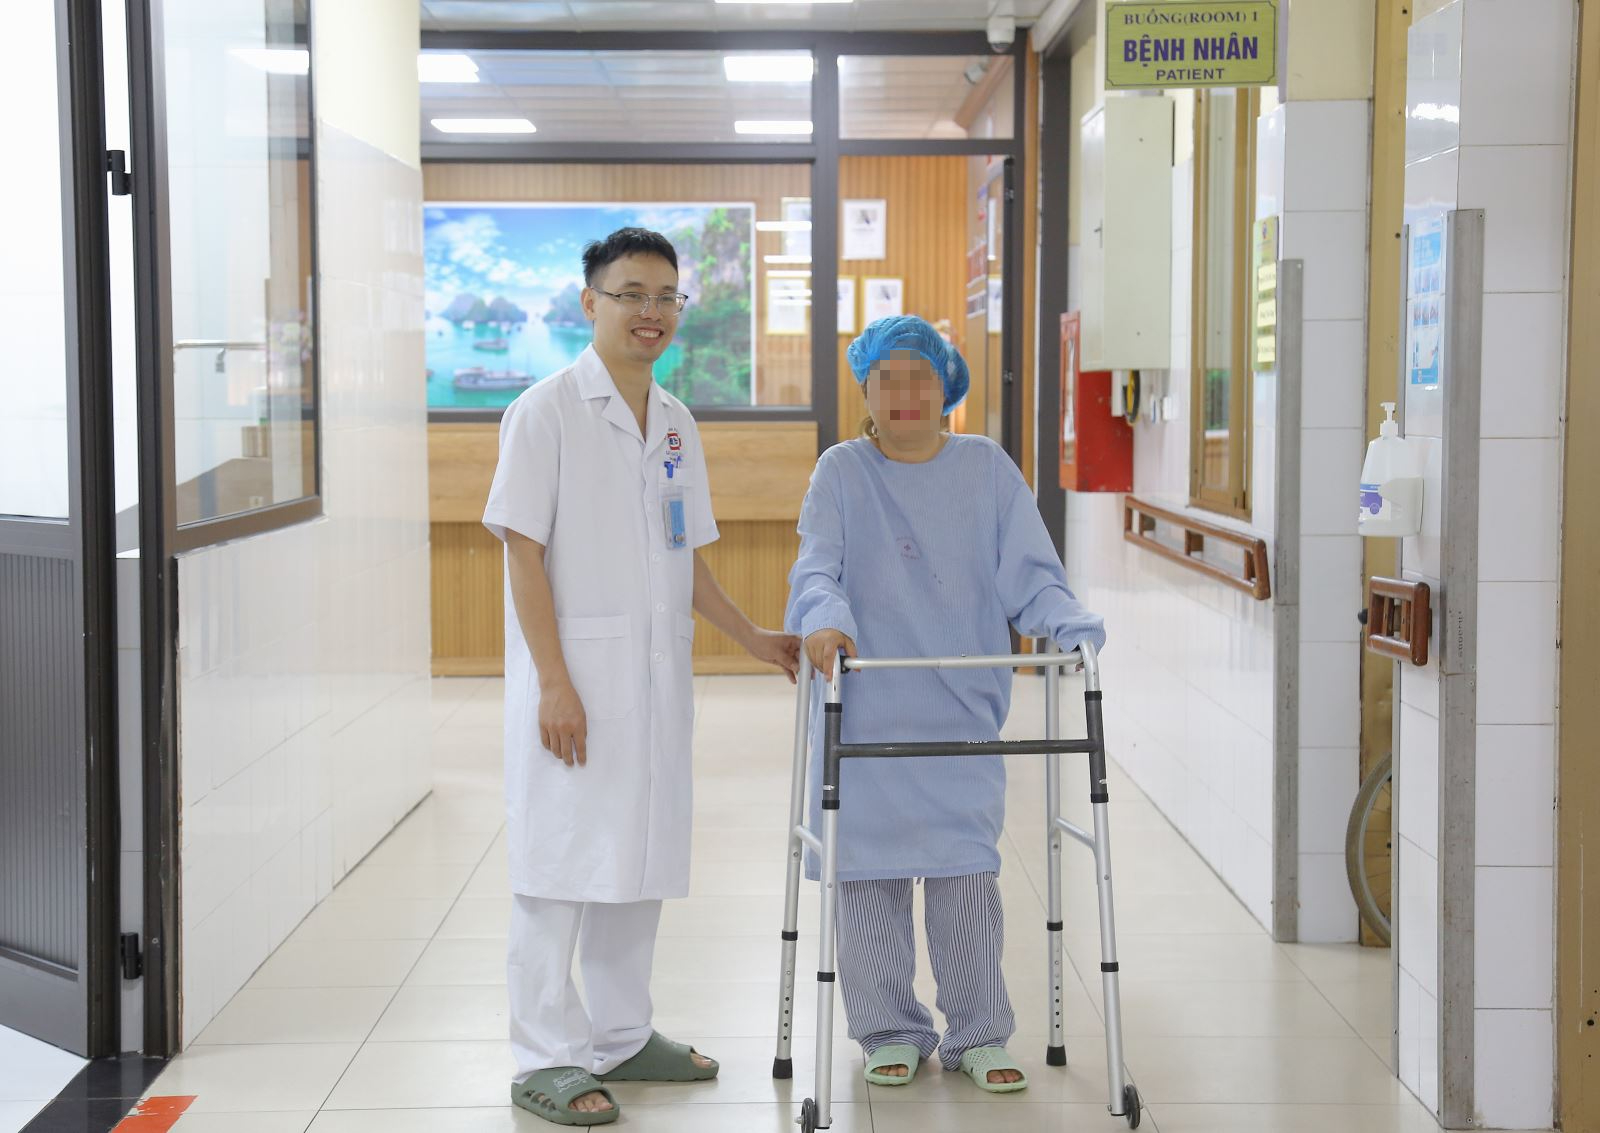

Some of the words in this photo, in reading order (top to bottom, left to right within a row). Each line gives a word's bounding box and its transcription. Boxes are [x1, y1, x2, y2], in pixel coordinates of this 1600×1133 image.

[1252, 11, 1258, 22] 1
[1124, 34, 1185, 67] BỆNH
[1193, 32, 1258, 61] NHÂN
[1156, 68, 1225, 81] PATIENT
